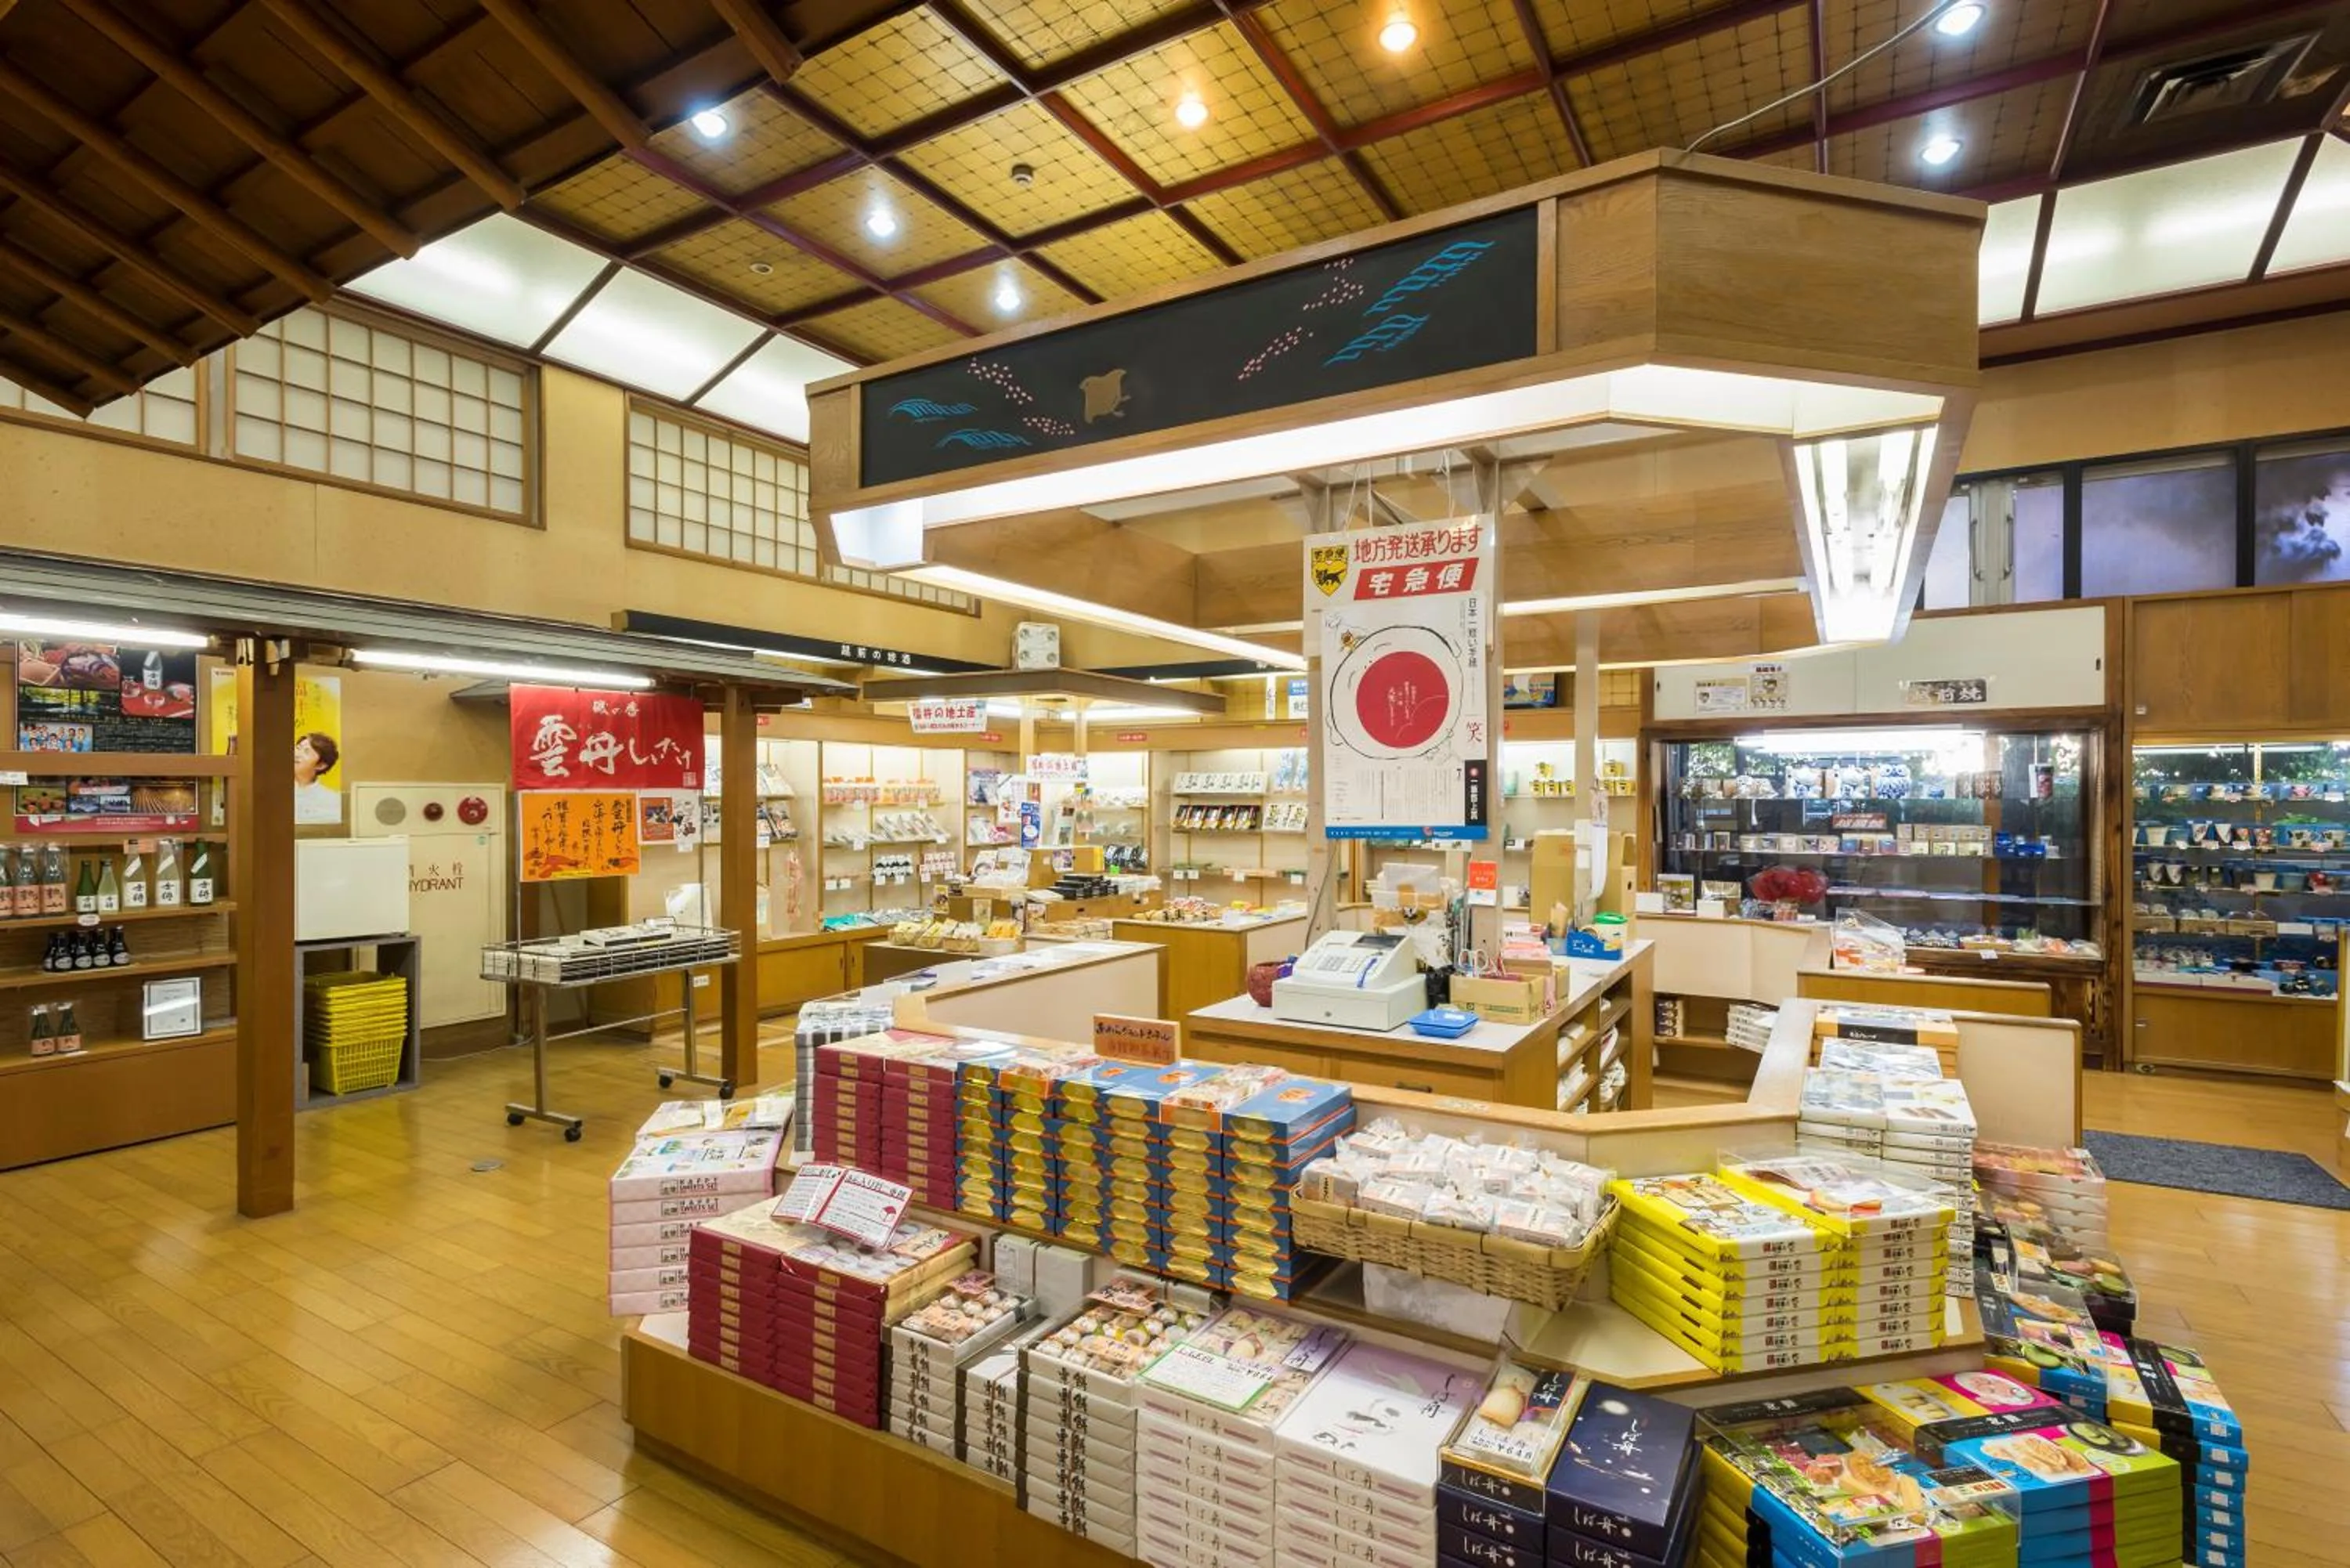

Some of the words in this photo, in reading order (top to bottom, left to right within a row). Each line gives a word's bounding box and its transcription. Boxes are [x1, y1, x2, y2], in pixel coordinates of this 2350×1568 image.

[1354, 524, 1484, 563] 地方発送承ります
[1368, 562, 1465, 595] 宅急便
[1466, 721, 1483, 743] 笑
